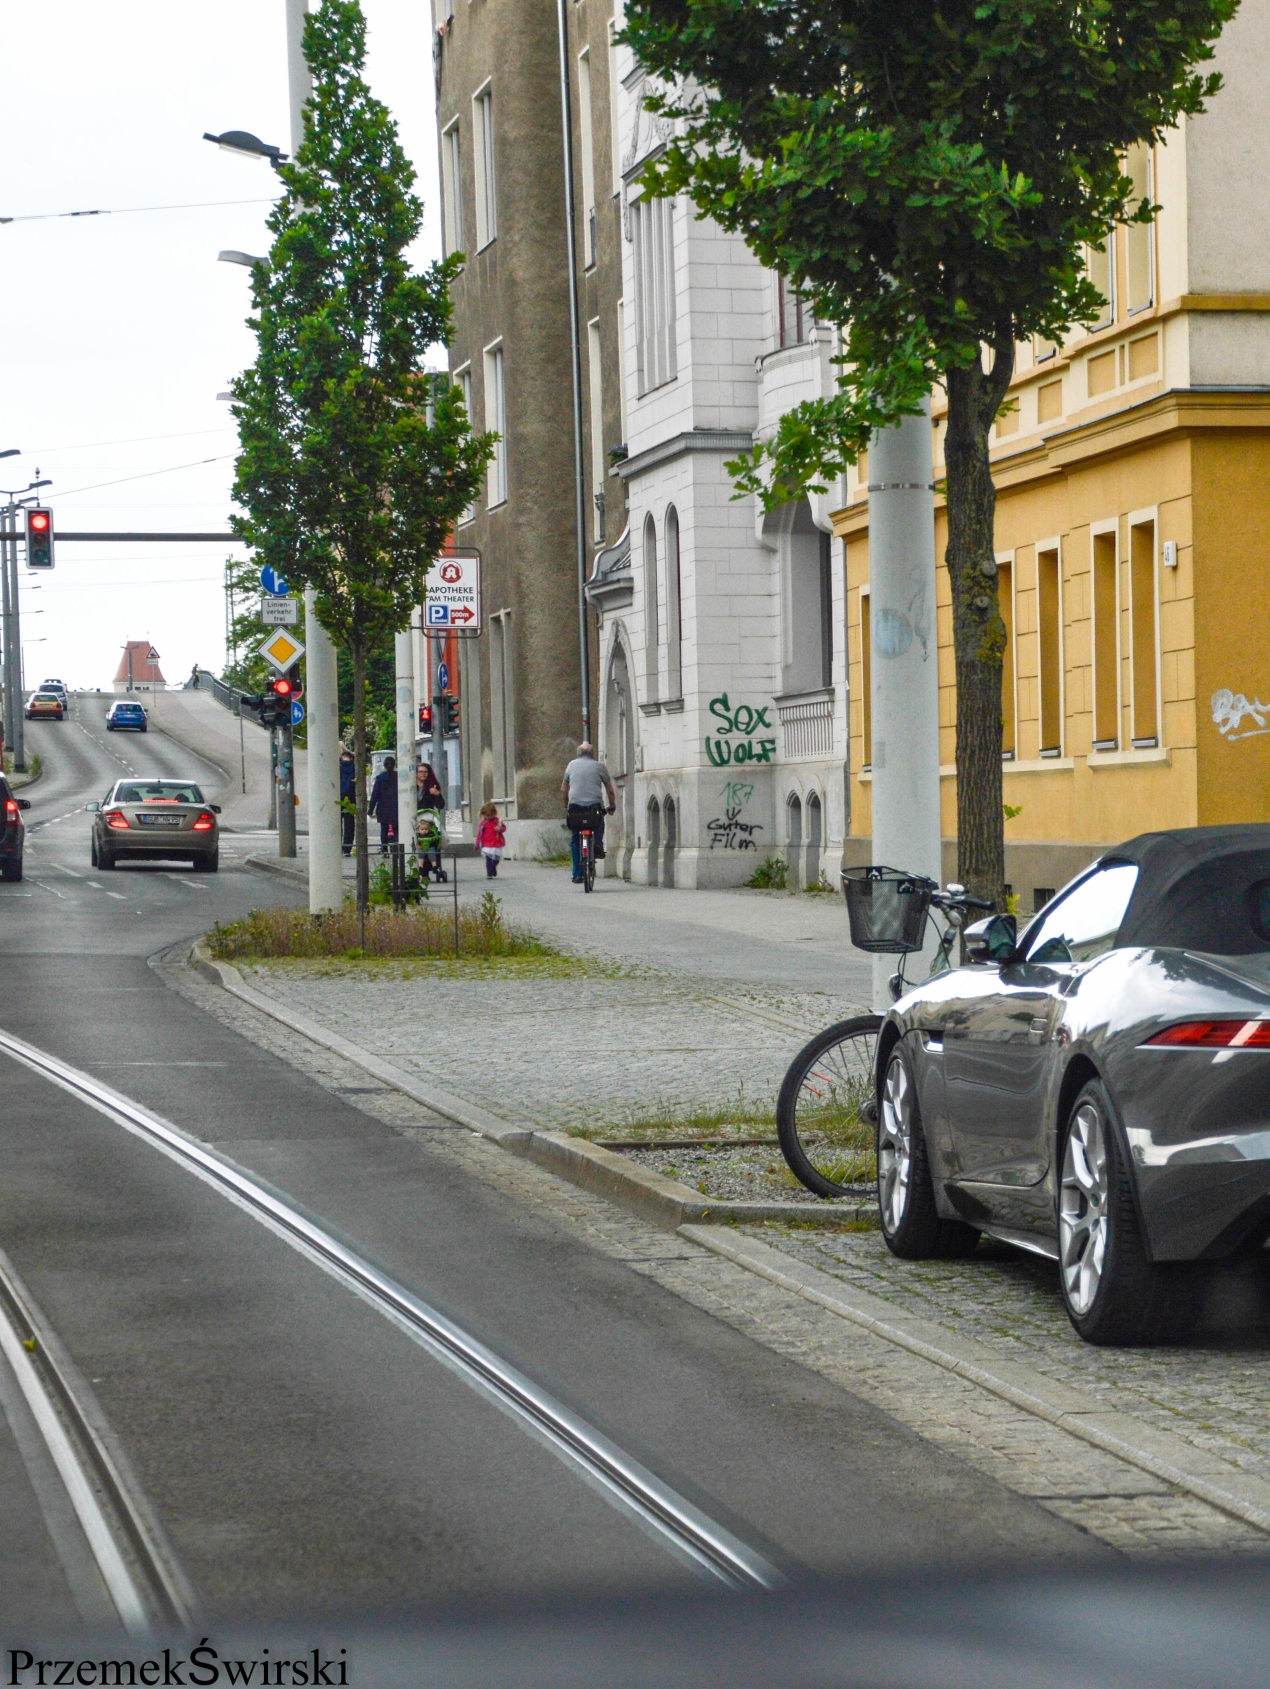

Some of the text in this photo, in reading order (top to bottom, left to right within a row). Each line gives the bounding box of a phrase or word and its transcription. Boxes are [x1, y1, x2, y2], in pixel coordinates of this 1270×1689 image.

[428, 586, 474, 594] APOTHEKE
[443, 595, 475, 603] THEATER
[719, 782, 754, 806] 187
